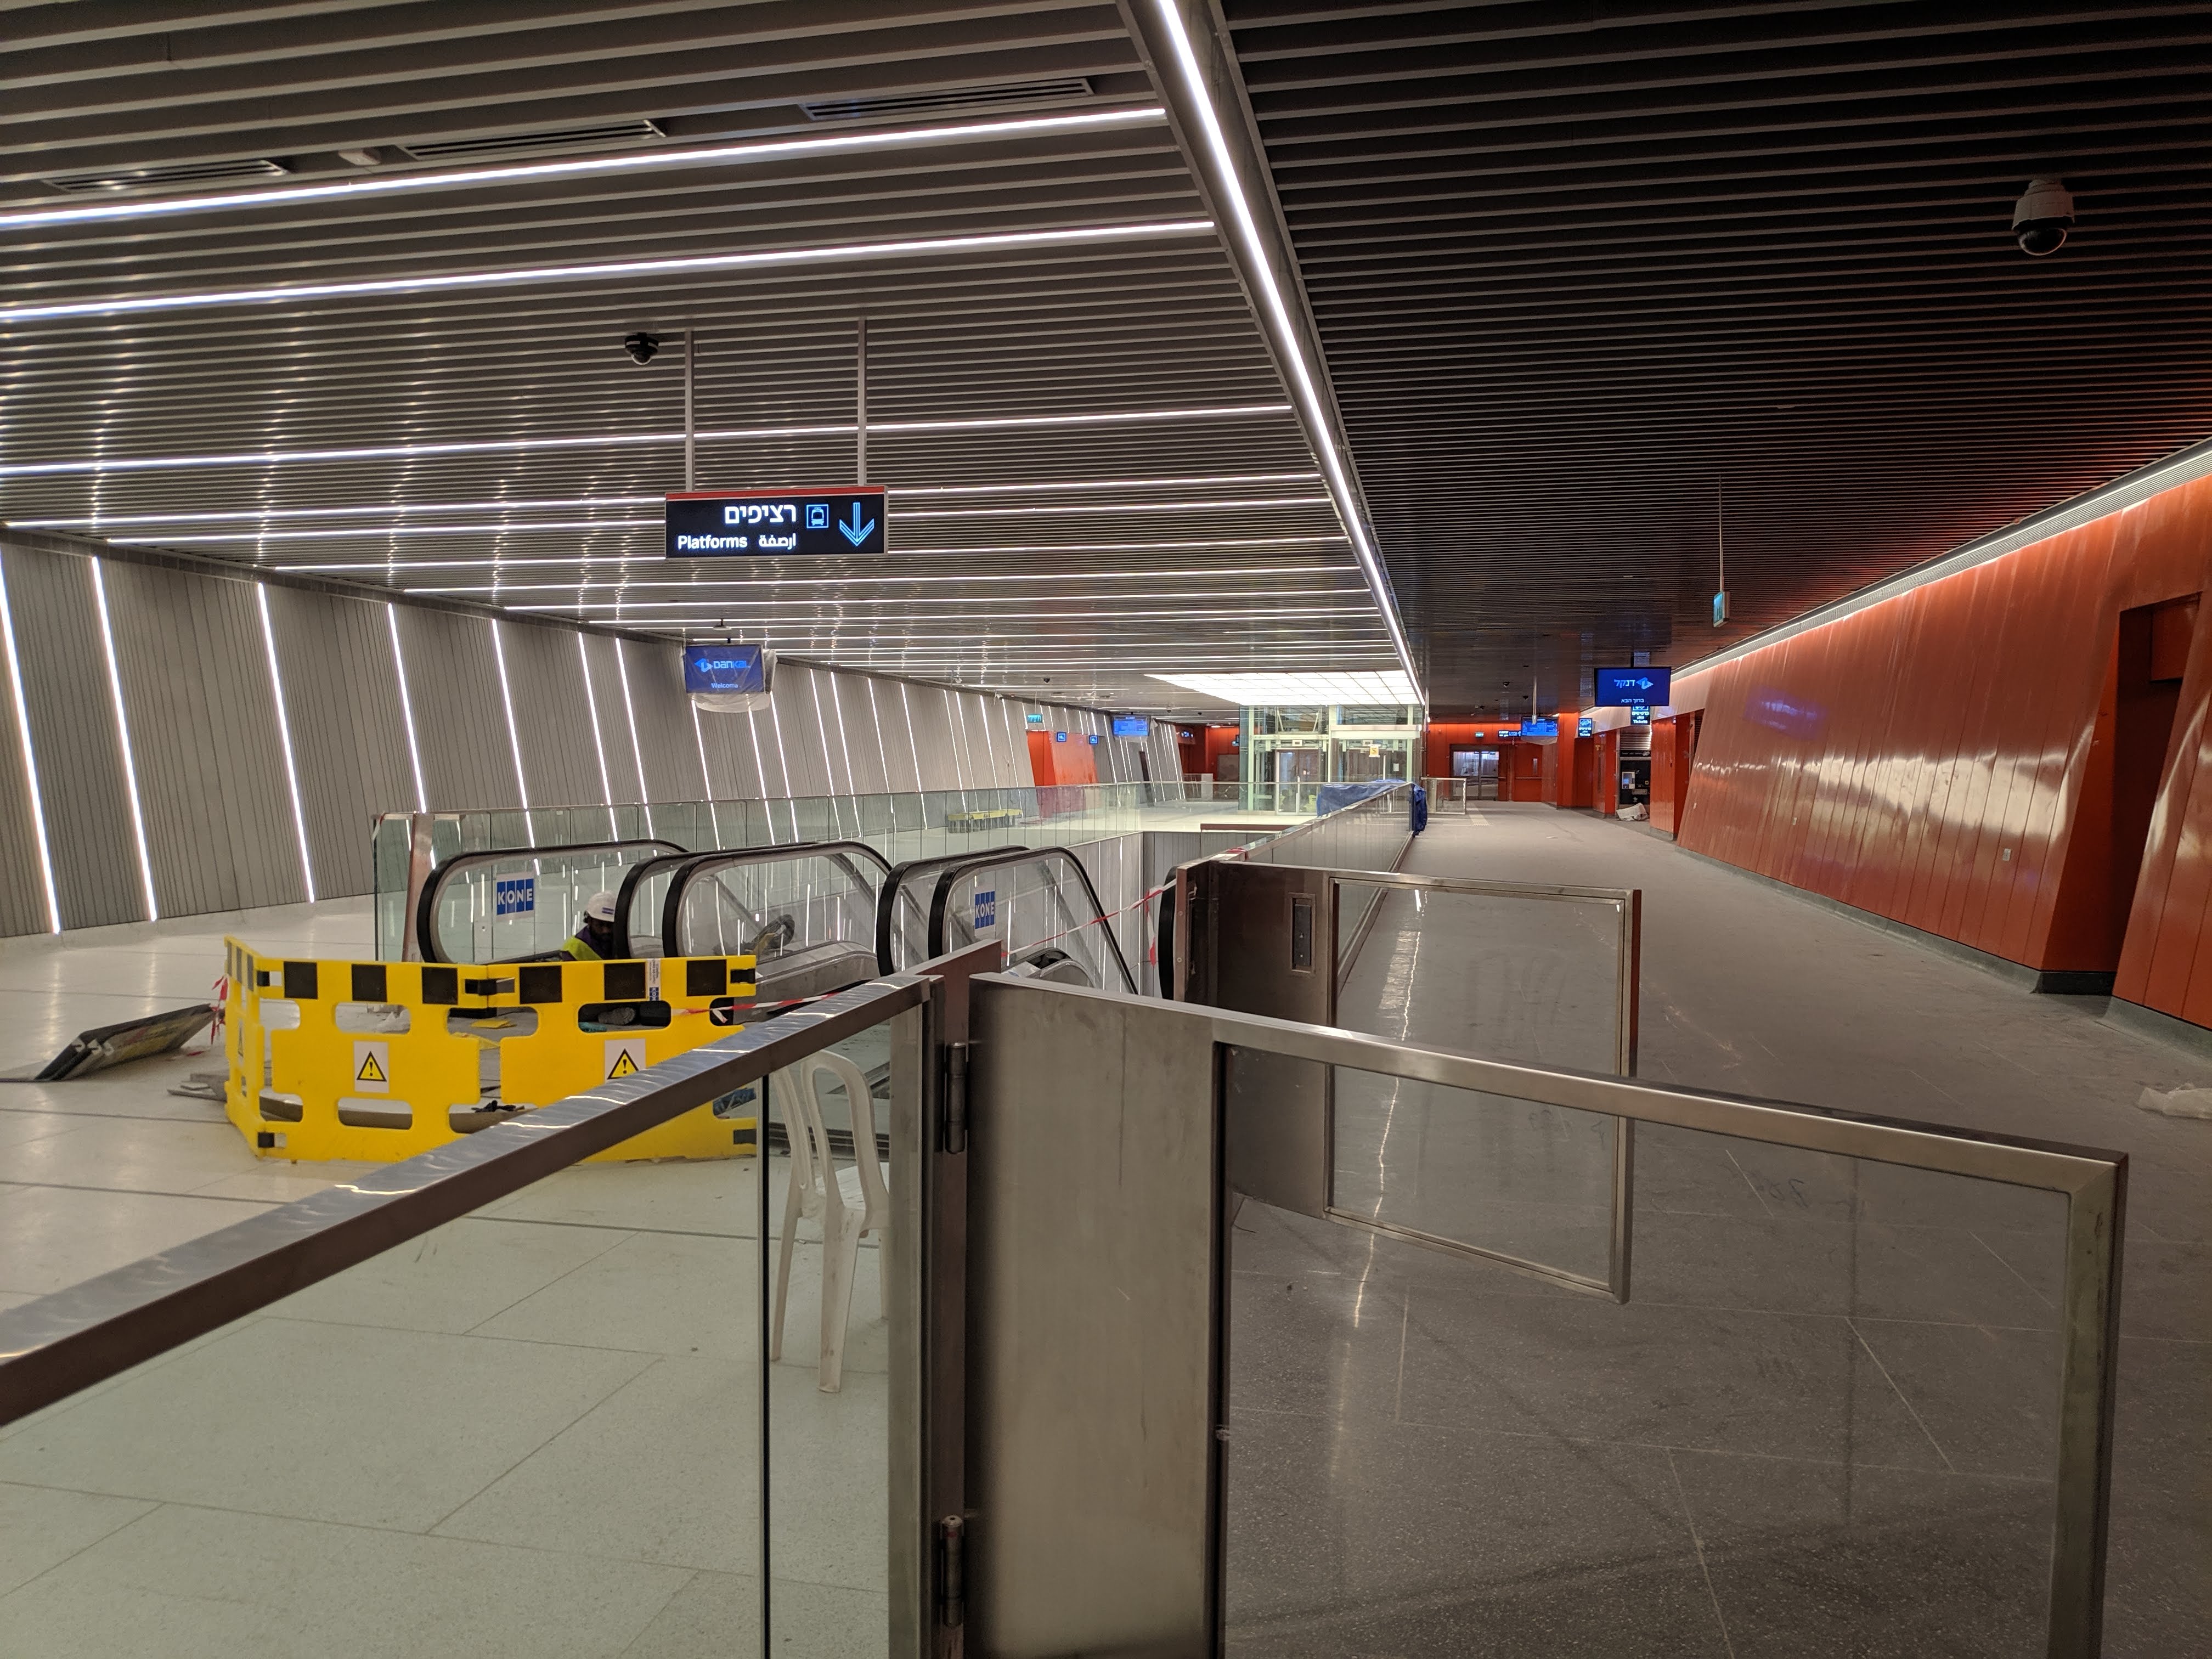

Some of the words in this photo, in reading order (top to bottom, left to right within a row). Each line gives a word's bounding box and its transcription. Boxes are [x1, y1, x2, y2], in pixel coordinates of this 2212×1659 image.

[725, 504, 796, 524] רציפים
[678, 534, 748, 549] Platforms
[1613, 679, 1635, 689] דנקל
[498, 888, 533, 905] KONE
[975, 901, 994, 918] KONE
